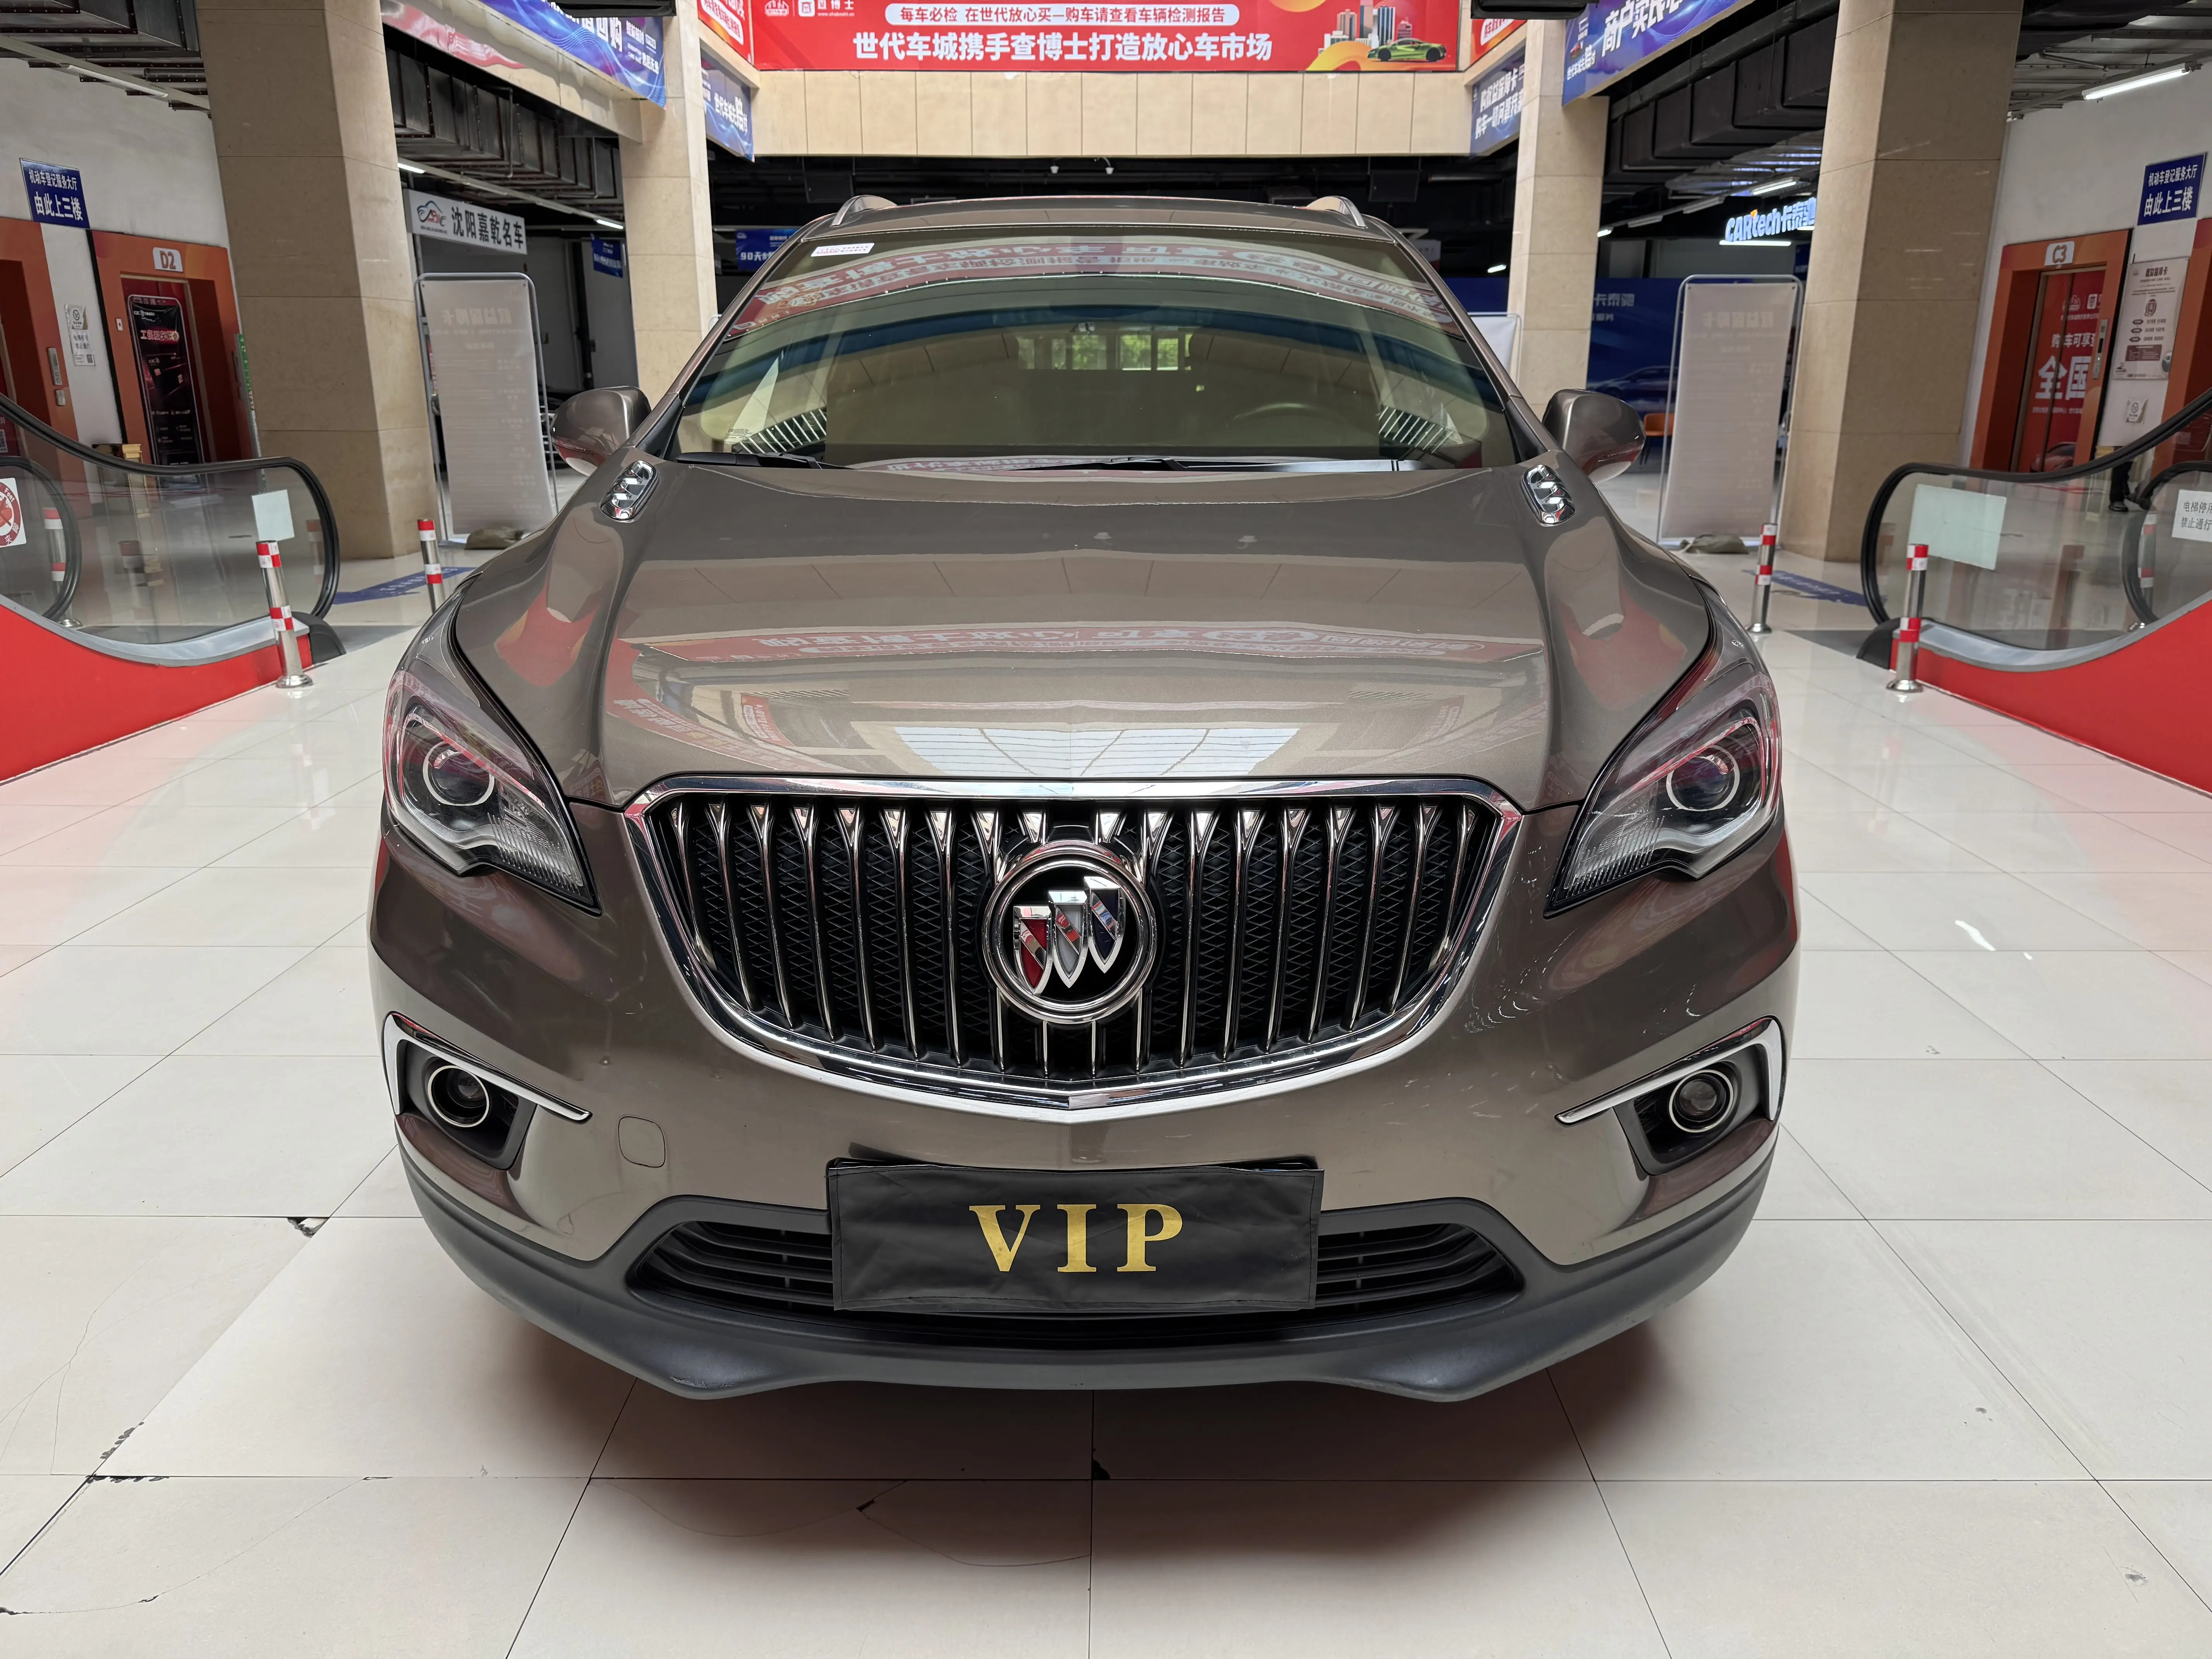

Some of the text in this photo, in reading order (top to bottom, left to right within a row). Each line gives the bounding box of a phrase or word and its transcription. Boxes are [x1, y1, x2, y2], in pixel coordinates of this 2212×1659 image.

[900, 7, 957, 22] 每车必检
[853, 31, 1273, 61] 世代车城携手查博士打造放心车市场
[29, 168, 78, 191] 机动车登记服务大厅
[2148, 164, 2198, 187] 机动车登记服务大厅
[34, 192, 84, 221] 由此上三楼
[2143, 186, 2193, 217] 由此上三楼
[451, 206, 524, 249] 沈阳嘉乾名车
[159, 251, 177, 270] D2
[2052, 244, 2067, 264] C3
[4, 487, 15, 503] Foot
[968, 1203, 1183, 1272] VIP
